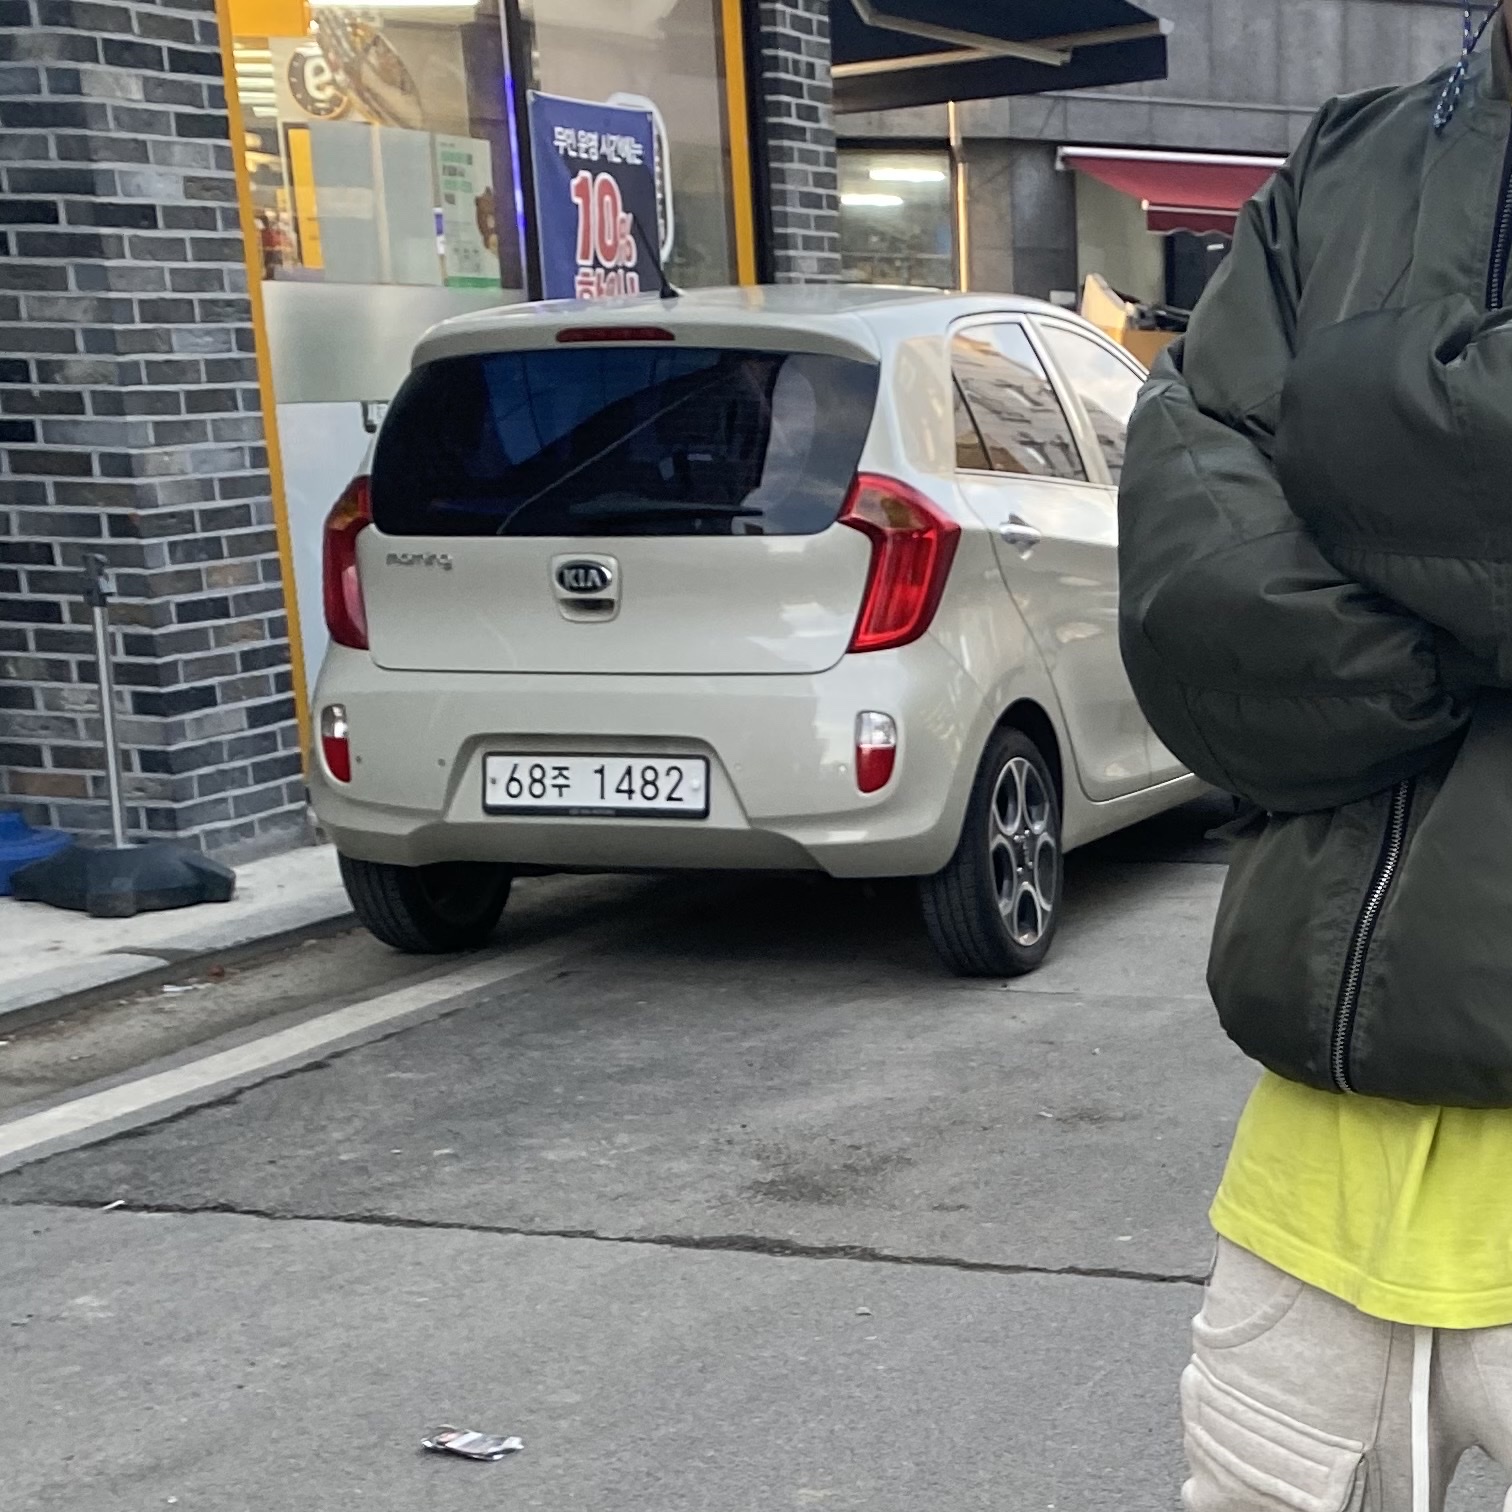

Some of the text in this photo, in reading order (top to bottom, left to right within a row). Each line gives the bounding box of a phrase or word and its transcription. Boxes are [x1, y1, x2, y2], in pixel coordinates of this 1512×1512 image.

[563, 568, 602, 588] KIA
[506, 763, 684, 802] 68주 1482
